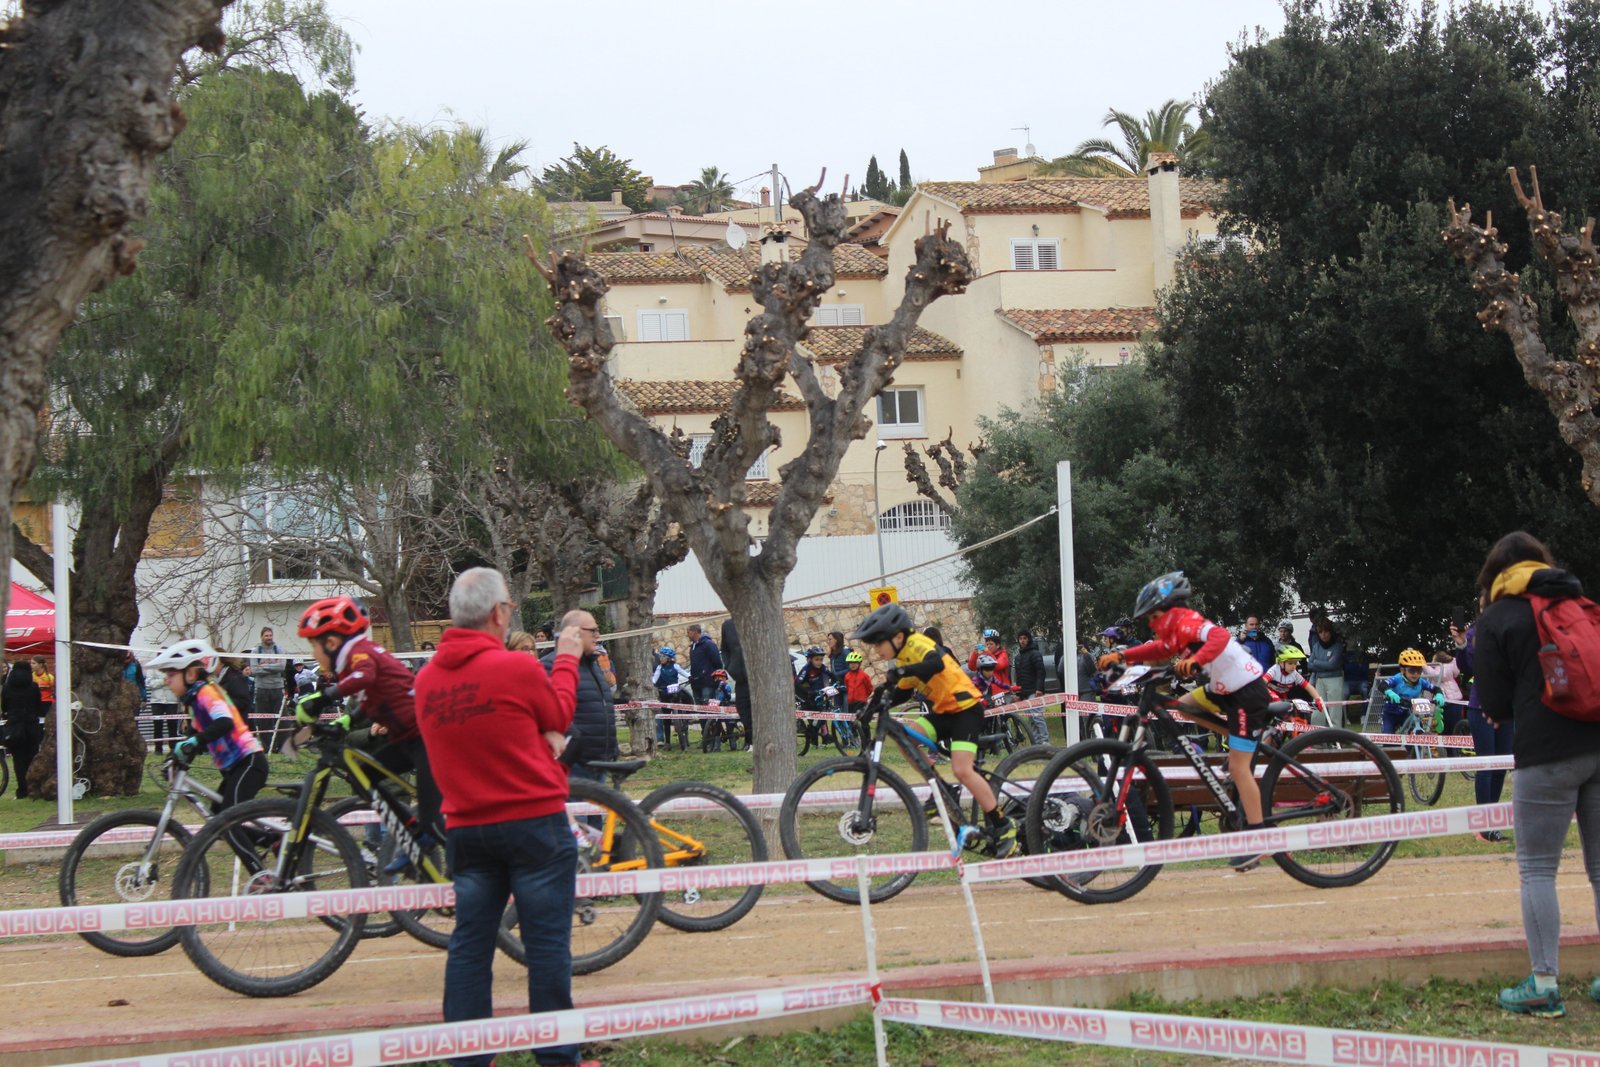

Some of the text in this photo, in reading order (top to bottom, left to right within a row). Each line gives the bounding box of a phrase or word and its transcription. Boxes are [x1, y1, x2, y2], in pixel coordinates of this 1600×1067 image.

[1415, 703, 1431, 713] 423
[1406, 735, 1439, 744] BAUHAUS
[1178, 735, 1237, 812] ROCKRIDER
